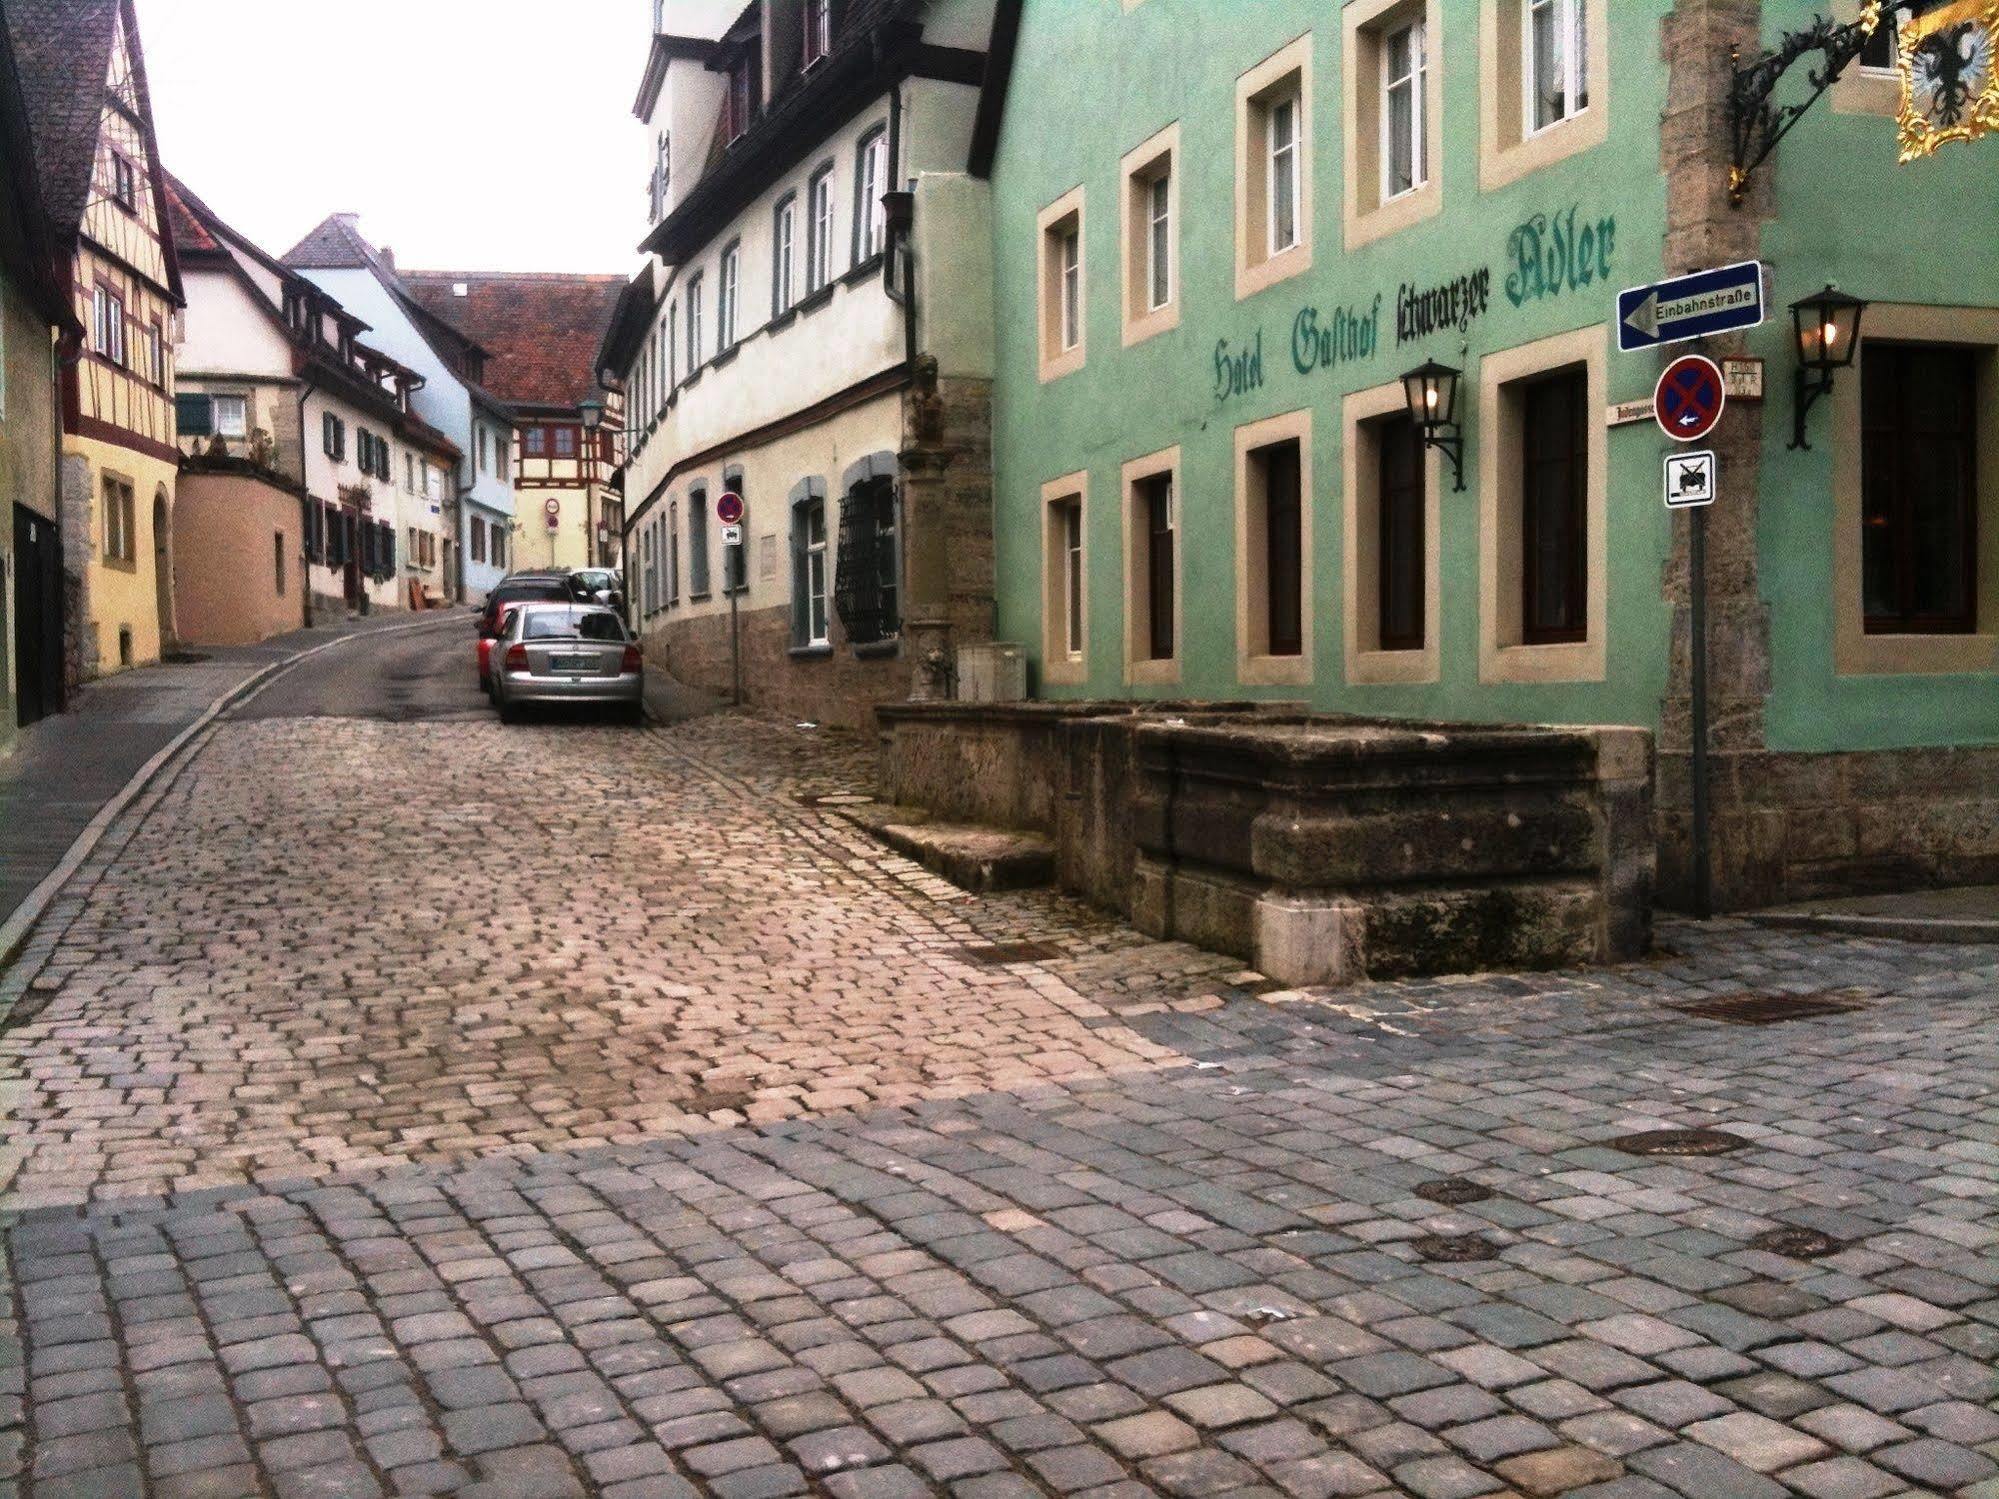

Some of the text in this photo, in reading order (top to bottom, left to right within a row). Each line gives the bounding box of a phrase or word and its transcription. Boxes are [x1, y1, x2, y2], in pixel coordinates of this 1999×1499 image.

[1213, 326, 1263, 402] Hotel
[1505, 202, 1615, 308] Adler
[1656, 289, 1751, 320] Einbahnstraße
